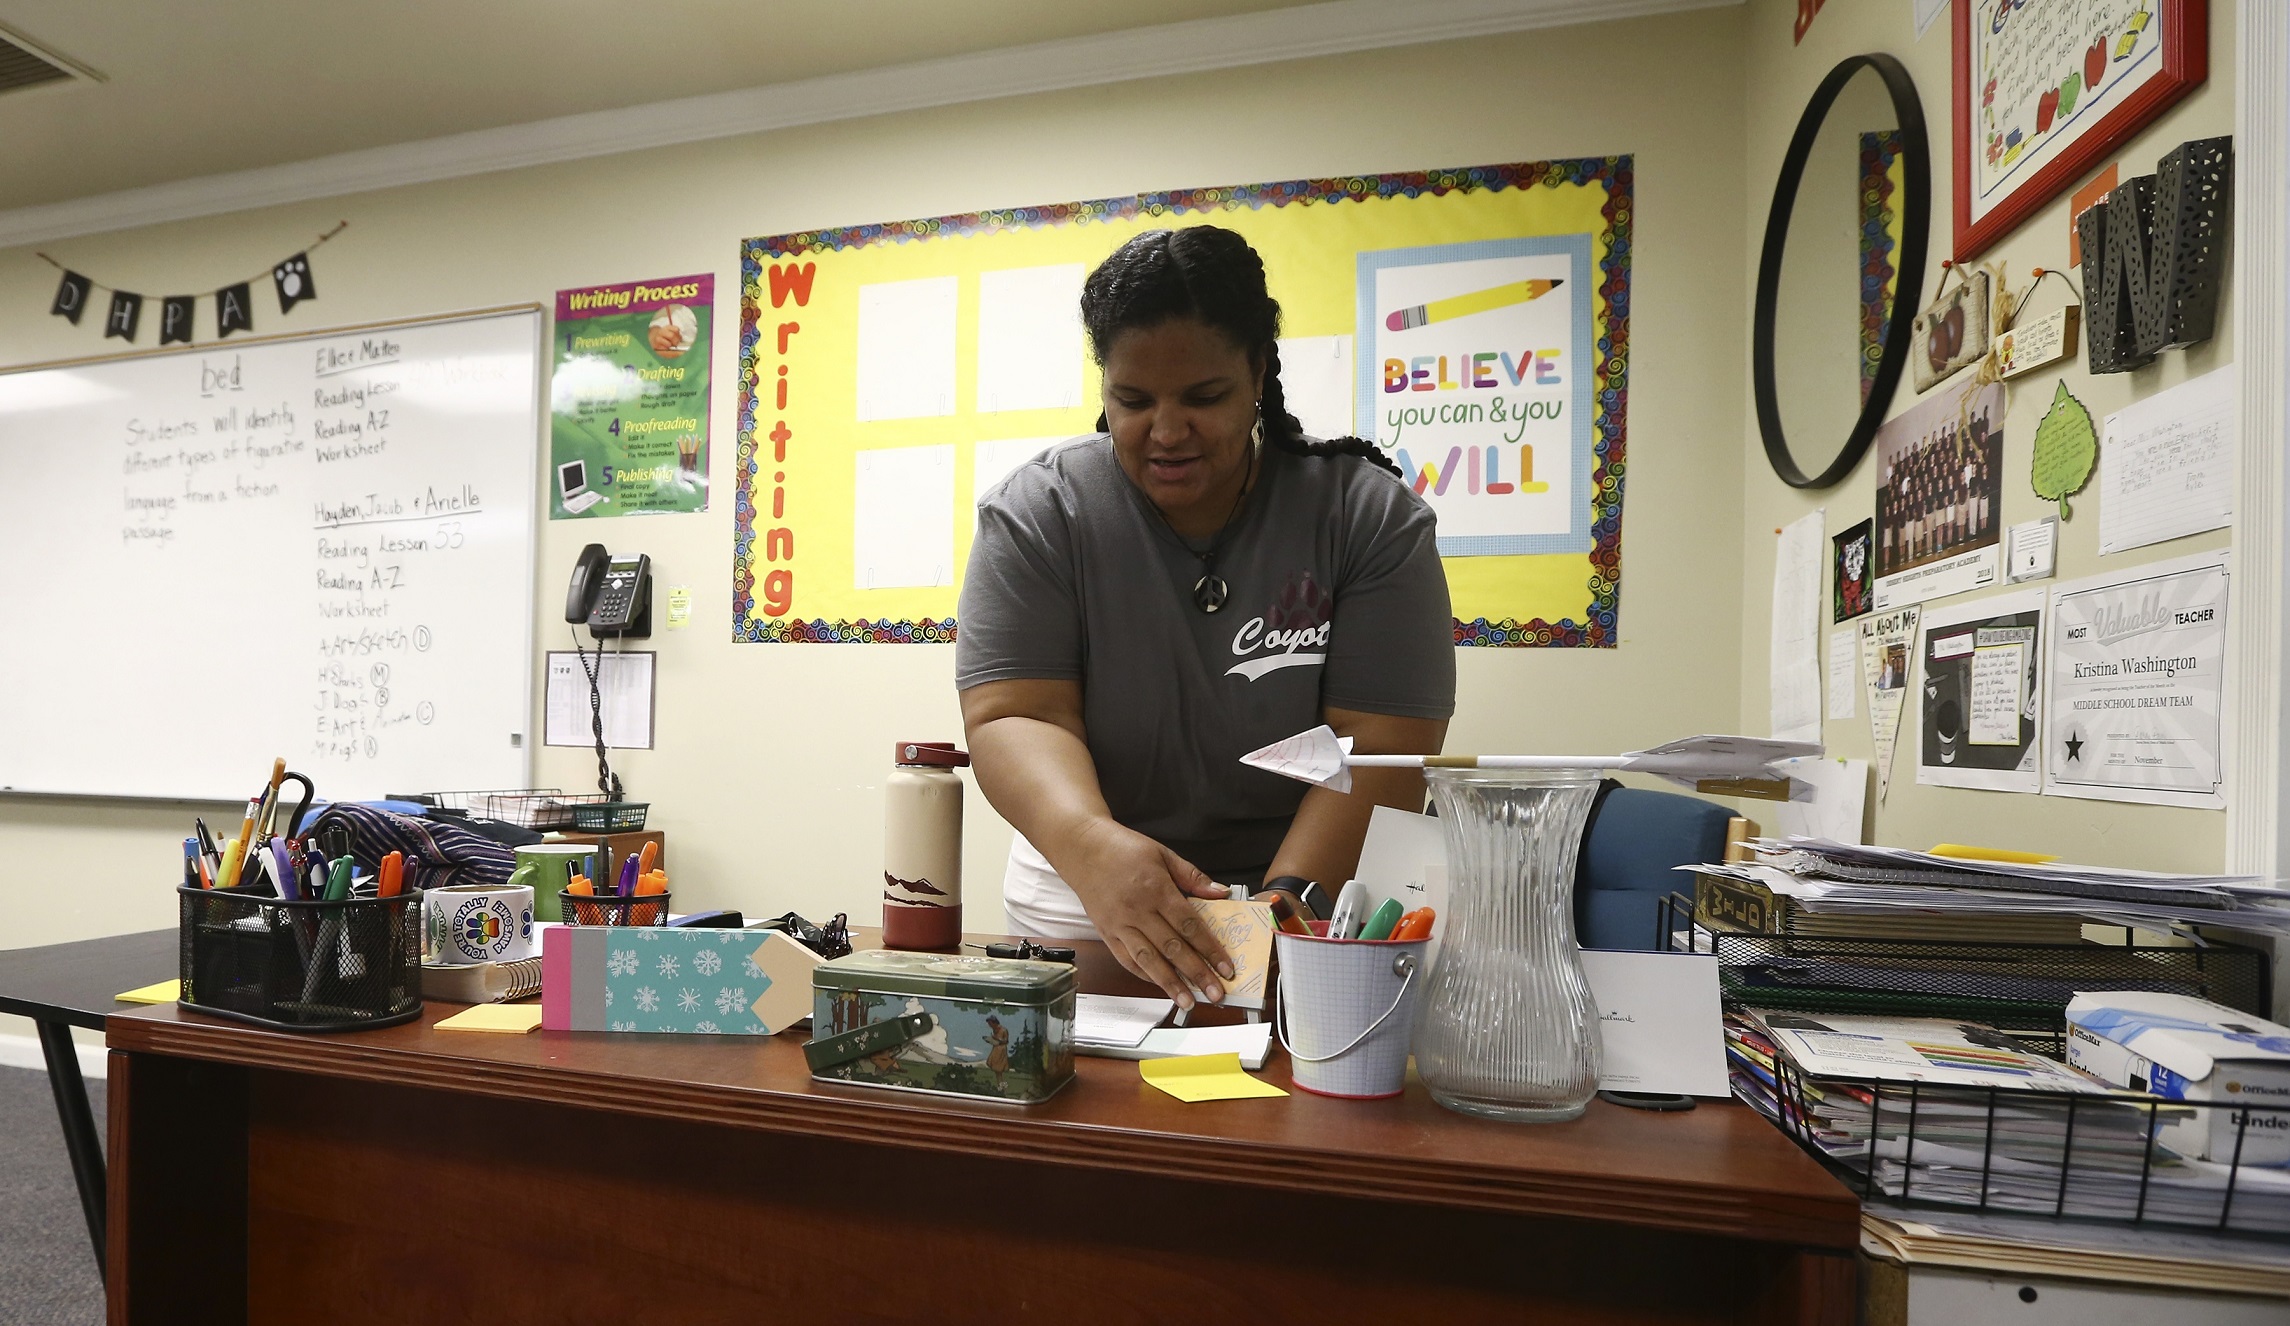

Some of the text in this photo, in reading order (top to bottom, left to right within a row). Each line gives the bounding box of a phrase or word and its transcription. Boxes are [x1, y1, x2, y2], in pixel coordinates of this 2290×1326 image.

[569, 282, 699, 310] Writing Process
[574, 332, 630, 350] Prewriting
[201, 353, 242, 392] bed
[637, 365, 685, 382] Drafting
[1384, 348, 1562, 393] BELIEVE
[314, 380, 400, 409] Reading Lesson
[125, 401, 296, 446] Students will identify
[314, 409, 389, 442] Reading A-Z
[608, 416, 697, 437] 4 Proofreading
[1380, 396, 1562, 448] you can & you
[316, 437, 386, 463] Worksheet
[651, 441, 672, 449] correct
[763, 261, 816, 617] Writing
[123, 435, 304, 477] different types of figurative
[1396, 443, 1549, 497] WILL
[602, 466, 673, 486] 5 Publishing
[636, 483, 650, 491] copy
[124, 474, 279, 522] language from a fiction
[424, 484, 480, 515] Arielle
[122, 526, 174, 549] passage
[317, 521, 464, 569] Reading Lesson 53
[1922, 563, 1956, 577] PREPARATORY
[1956, 554, 1981, 568] ACADEMY
[1977, 568, 1991, 578] 2018
[316, 565, 405, 602] Reading A-Z
[318, 597, 390, 618] Worksheet
[1902, 611, 1916, 631] Me
[2067, 592, 2214, 640] MOST Valuable TEACHER
[1232, 617, 1331, 656] Coyot
[2073, 656, 2197, 679] Kristina Washington
[2073, 695, 2194, 711] MIDDLE SCHOOL DREAM TEAM
[2134, 756, 2164, 765] November
[453, 897, 489, 932] TOTALLY
[1713, 886, 1760, 929] WILD
[491, 900, 514, 955] PAWSOME!
[453, 932, 489, 960] YOU'RE
[1600, 1014, 1636, 1023] allmark
[2074, 1028, 2102, 1047] OfficeMax
[2242, 1084, 2289, 1096] OfficeM
